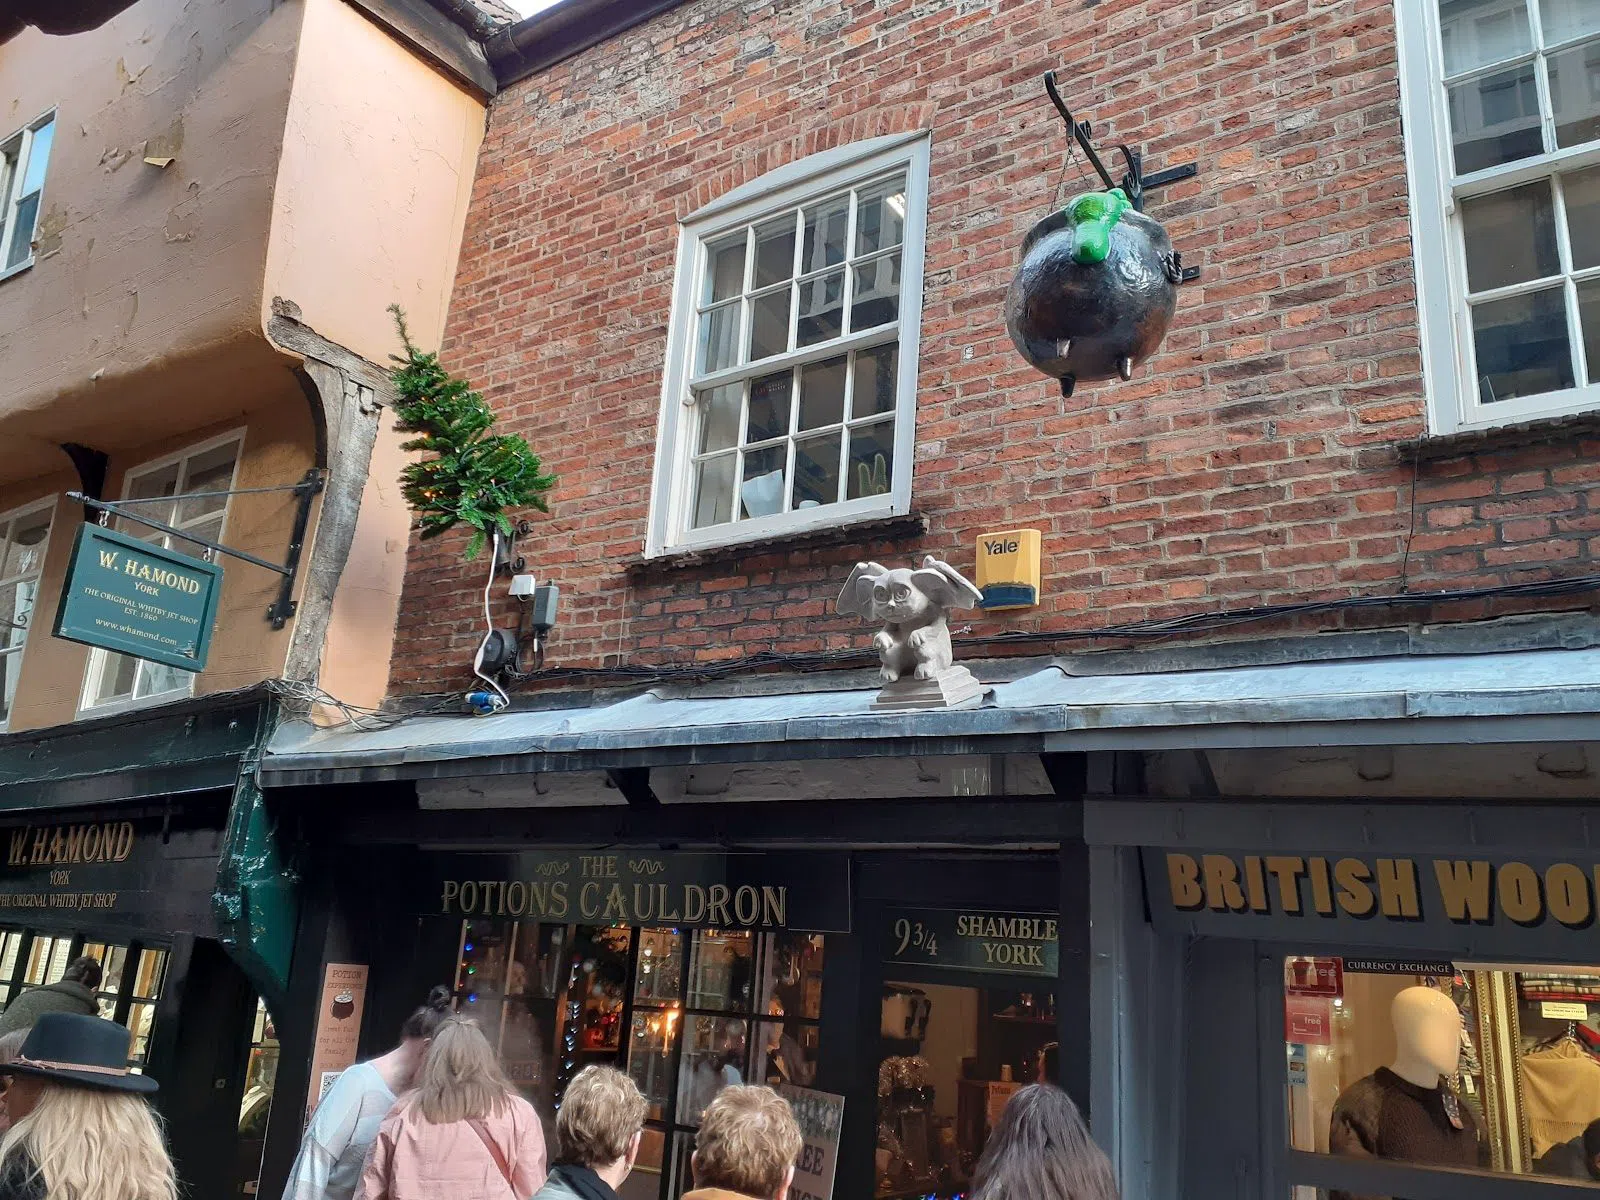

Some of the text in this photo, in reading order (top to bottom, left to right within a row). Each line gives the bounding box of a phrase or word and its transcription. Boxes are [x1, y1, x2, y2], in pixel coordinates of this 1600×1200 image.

[984, 539, 1017, 555] Yale
[99, 550, 200, 595] W. HAMOND
[134, 582, 160, 597] YORK
[84, 587, 199, 625] THE ORIGINAL WHITBY JET SHOP
[124, 607, 158, 622] EST. 1860
[95, 618, 177, 646] www.whamond.com
[8, 821, 135, 865] W. HAMOND
[49, 870, 72, 885] YORK
[578, 856, 619, 878] THE
[1166, 853, 1600, 926] BRITISH WOO
[12, 893, 47, 907] ORIGINAL
[49, 893, 80, 908] WHITBY
[77, 893, 93, 911] JET
[93, 893, 117, 908] SHOP
[440, 880, 787, 928] POTIONS CAULDRON
[956, 915, 1058, 941] SHAMBLE
[982, 942, 1044, 966] YORK
[332, 969, 362, 979] POTION
[1347, 961, 1450, 974] CURRENCY EXCHANGE
